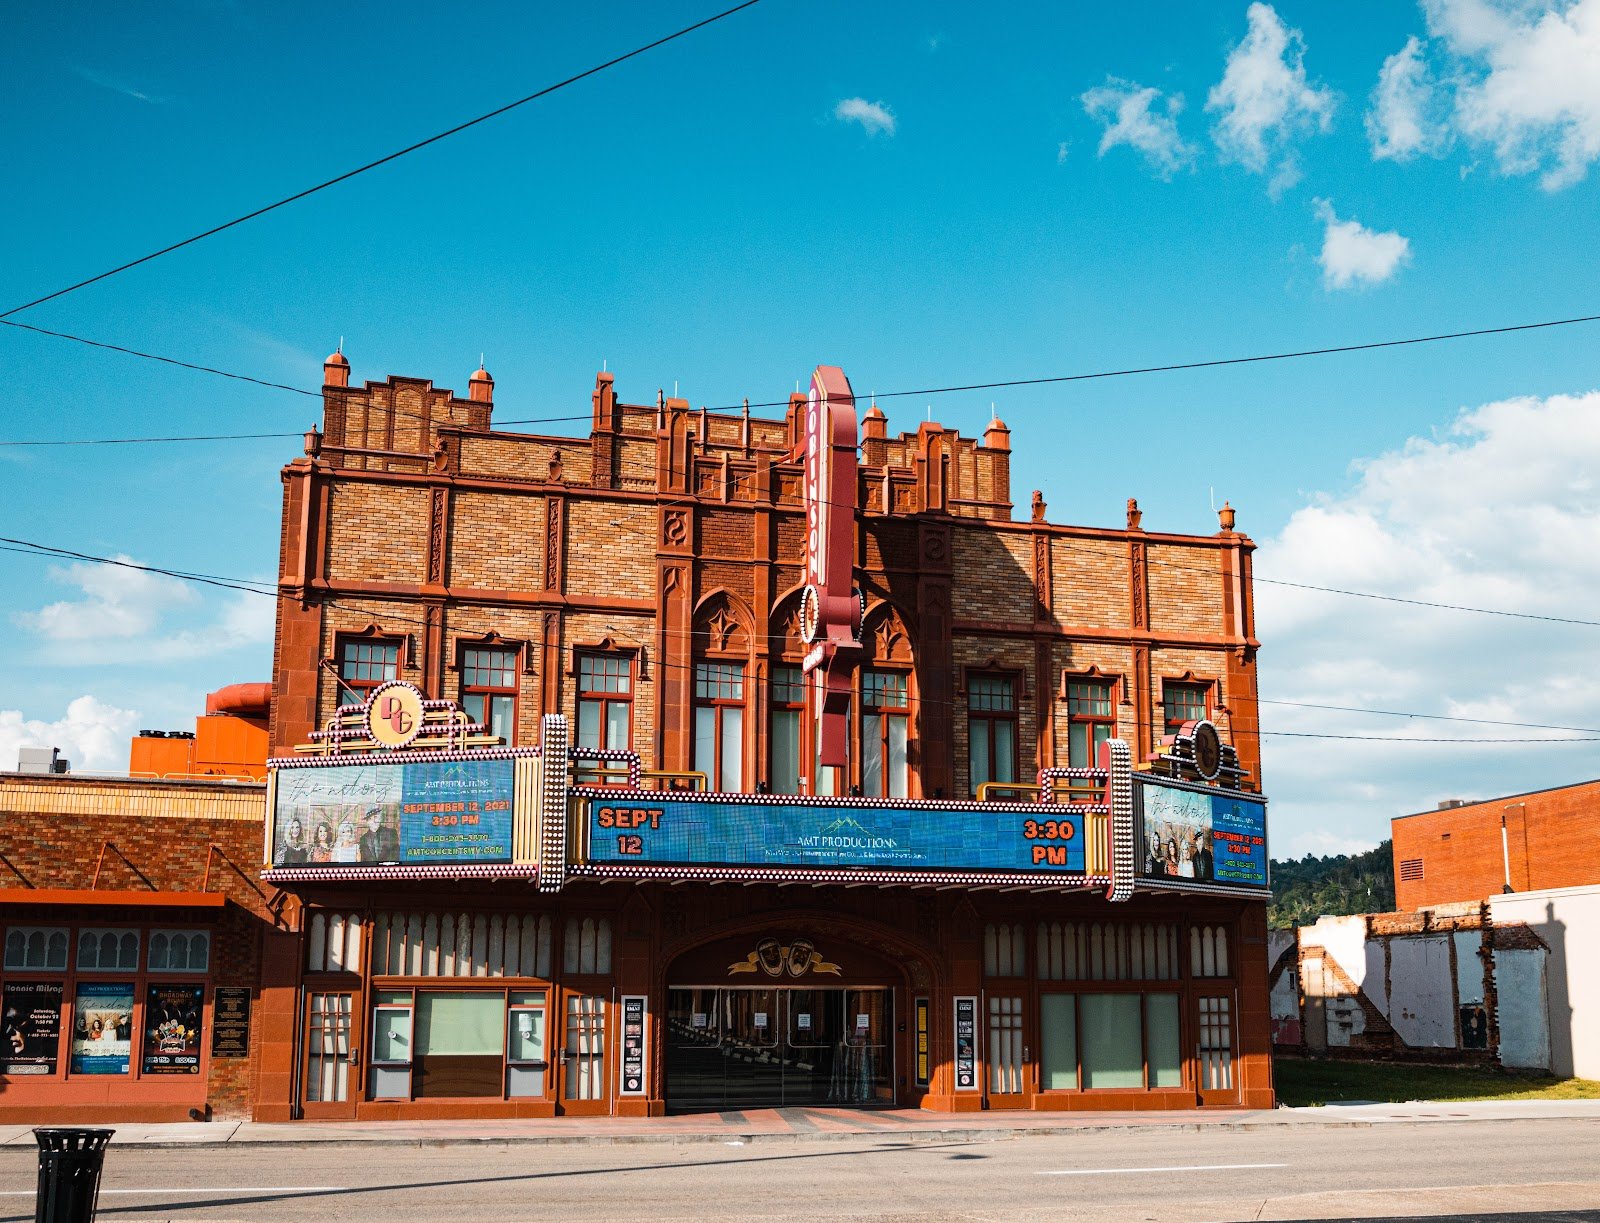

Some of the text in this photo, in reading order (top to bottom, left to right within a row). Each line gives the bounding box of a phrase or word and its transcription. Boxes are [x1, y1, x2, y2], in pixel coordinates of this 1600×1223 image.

[808, 388, 817, 577] ROBINSON
[403, 802, 465, 814] SEPTEMBER
[484, 800, 510, 812] 2021
[432, 814, 479, 826] 3:30 PM
[599, 807, 663, 829] SEPT
[1024, 820, 1074, 840] 3:30
[1213, 831, 1244, 843] SEPTEMBER
[618, 835, 642, 854] 12
[798, 836, 898, 849] AMT PRODUCTIONS
[1032, 846, 1066, 865] PM
[5, 984, 64, 993] Ronnie Milsap
